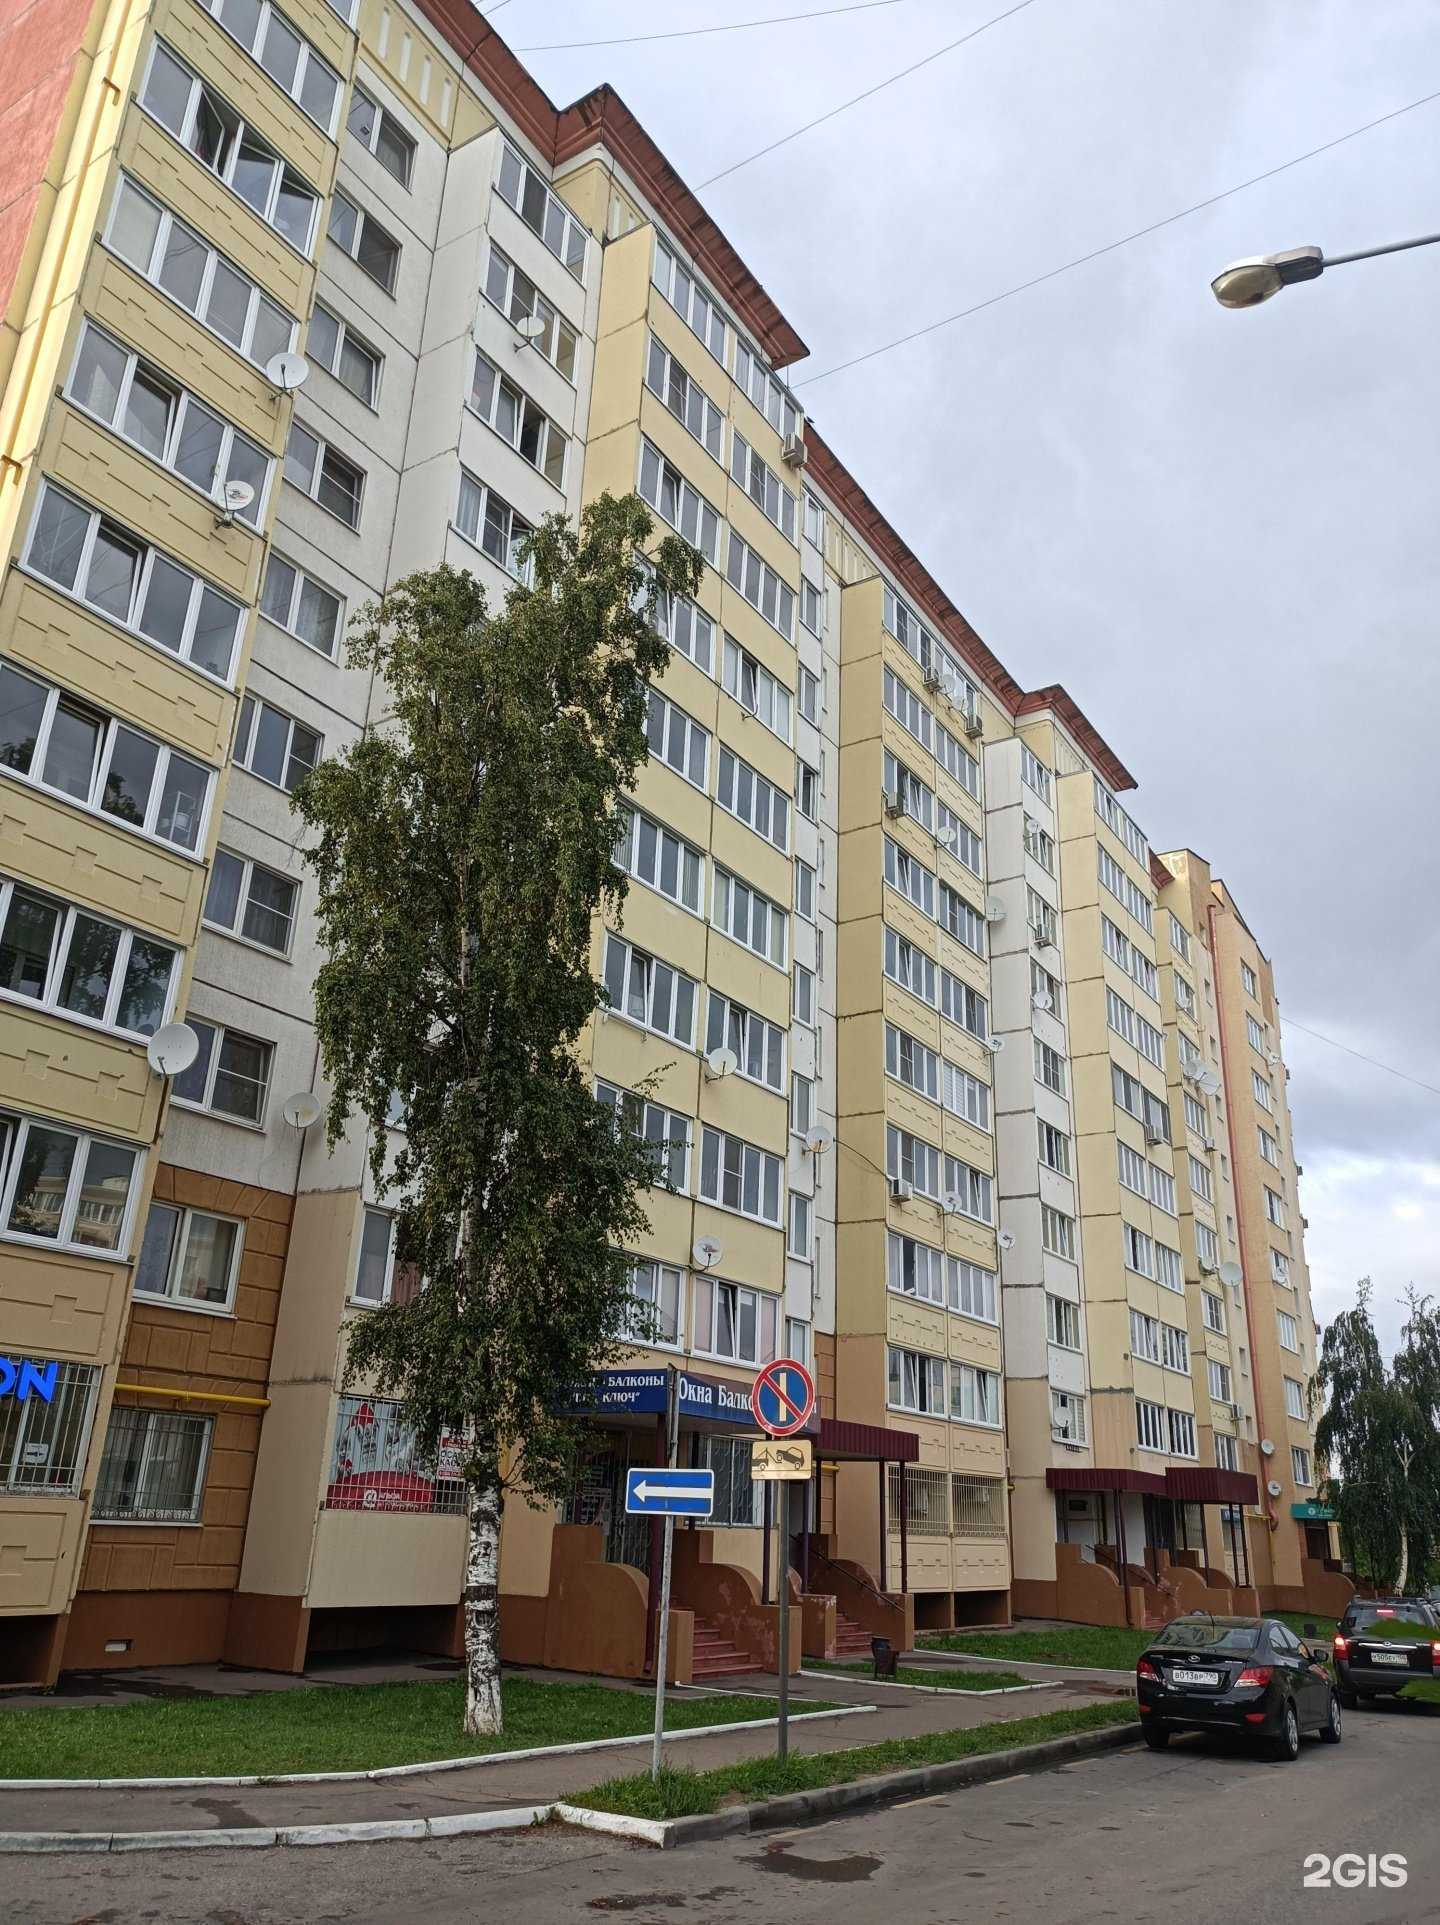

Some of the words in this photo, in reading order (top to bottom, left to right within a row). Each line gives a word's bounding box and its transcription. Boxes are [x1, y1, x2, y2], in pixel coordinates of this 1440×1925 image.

[608, 1375, 664, 1387] БАЛКОНЫ
[679, 1377, 712, 1404] Окна
[718, 1384, 753, 1412] Балко
